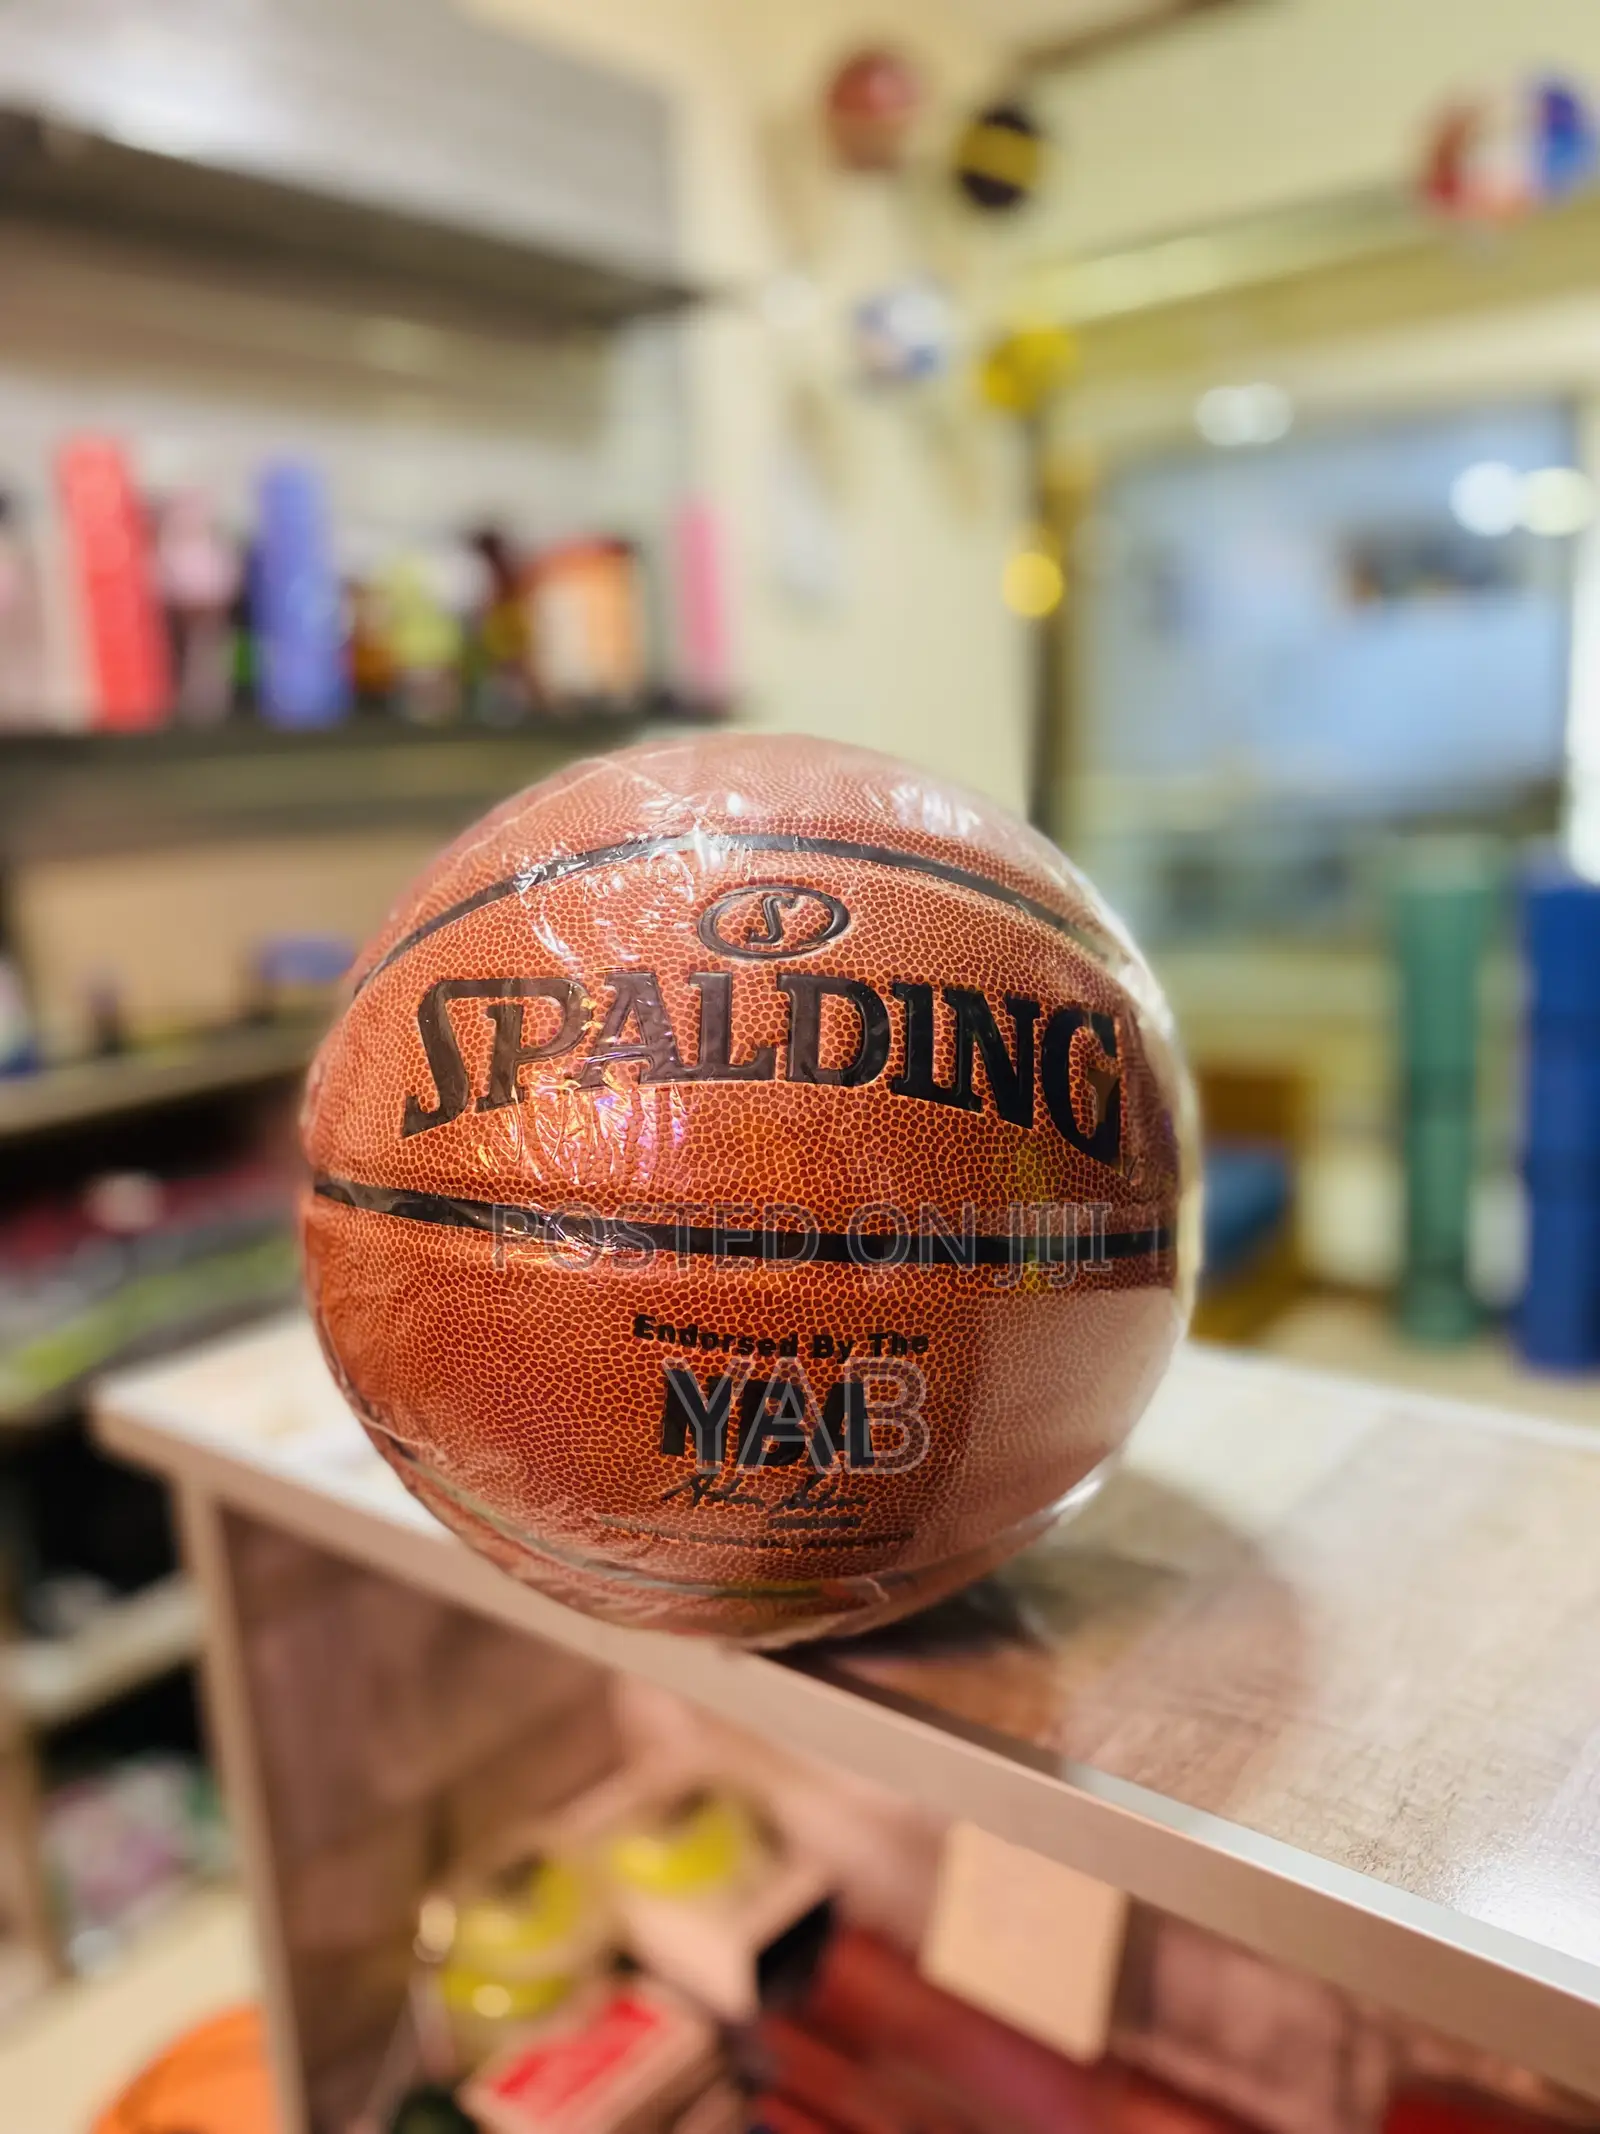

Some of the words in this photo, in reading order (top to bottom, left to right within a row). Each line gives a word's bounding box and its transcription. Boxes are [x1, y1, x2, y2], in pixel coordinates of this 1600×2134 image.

[402, 971, 1121, 1168] SPALDING
[633, 1314, 799, 1357] Endorsed
[811, 1332, 857, 1363] By
[867, 1331, 931, 1358] The
[661, 1369, 876, 1467] NBA
